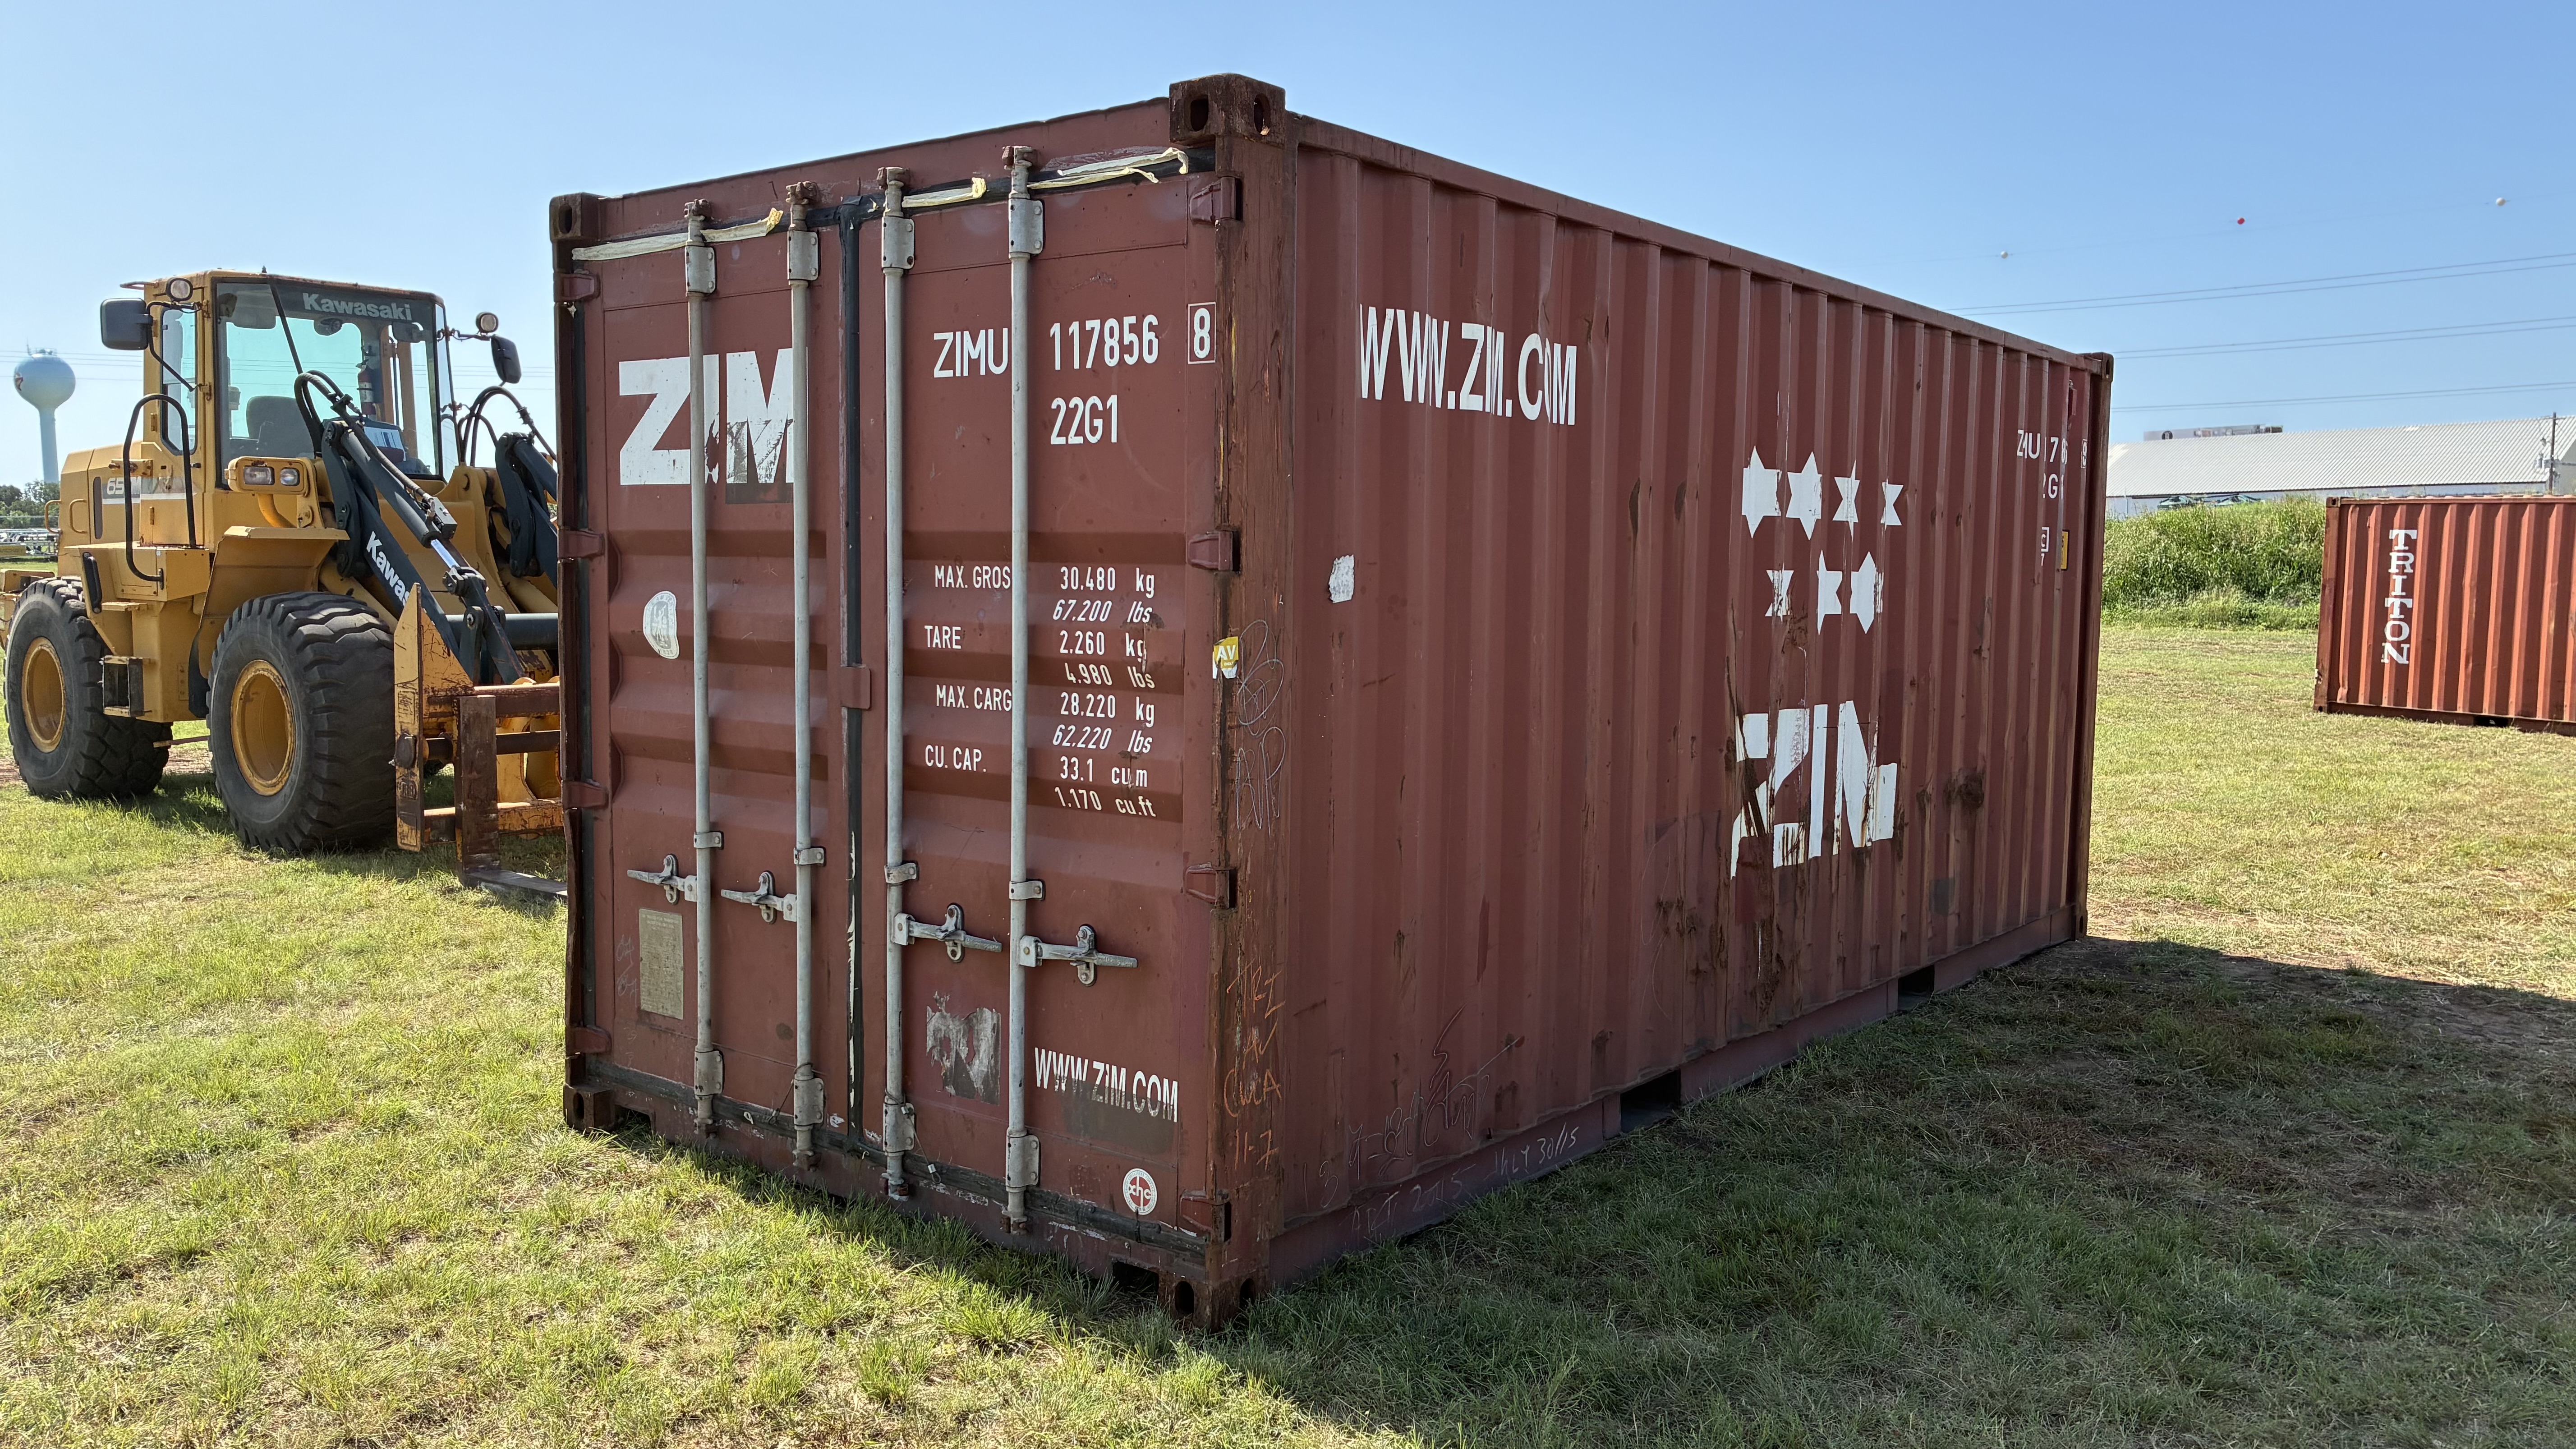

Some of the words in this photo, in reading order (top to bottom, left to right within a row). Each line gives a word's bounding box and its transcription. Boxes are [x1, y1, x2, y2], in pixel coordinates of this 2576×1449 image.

[303, 293, 412, 321] Kawasaki
[934, 327, 1008, 378] ZIMU
[1050, 314, 1159, 370] 117856
[1194, 308, 1210, 359] 8
[619, 346, 808, 485] ZIM
[1050, 394, 1118, 445] 22G1
[366, 531, 410, 607] Kawas
[935, 565, 968, 589] MAX.
[973, 566, 1011, 589] GROS
[1136, 567, 1155, 598] kg
[1127, 601, 1153, 623] lbs
[2381, 529, 2417, 664] TRITON
[924, 625, 961, 649] TARE
[1127, 665, 1155, 689] lbs
[936, 684, 969, 708] MAX.
[974, 687, 1012, 711] CARG
[1136, 696, 1155, 728] kg
[1127, 730, 1153, 753] lbs
[925, 745, 948, 768] CU.
[953, 747, 986, 772] CAP.
[1060, 756, 1094, 782] 33.1
[1115, 796, 1157, 817] cu.ft
[1034, 1047, 1178, 1122] WWW.ZIM.COM
